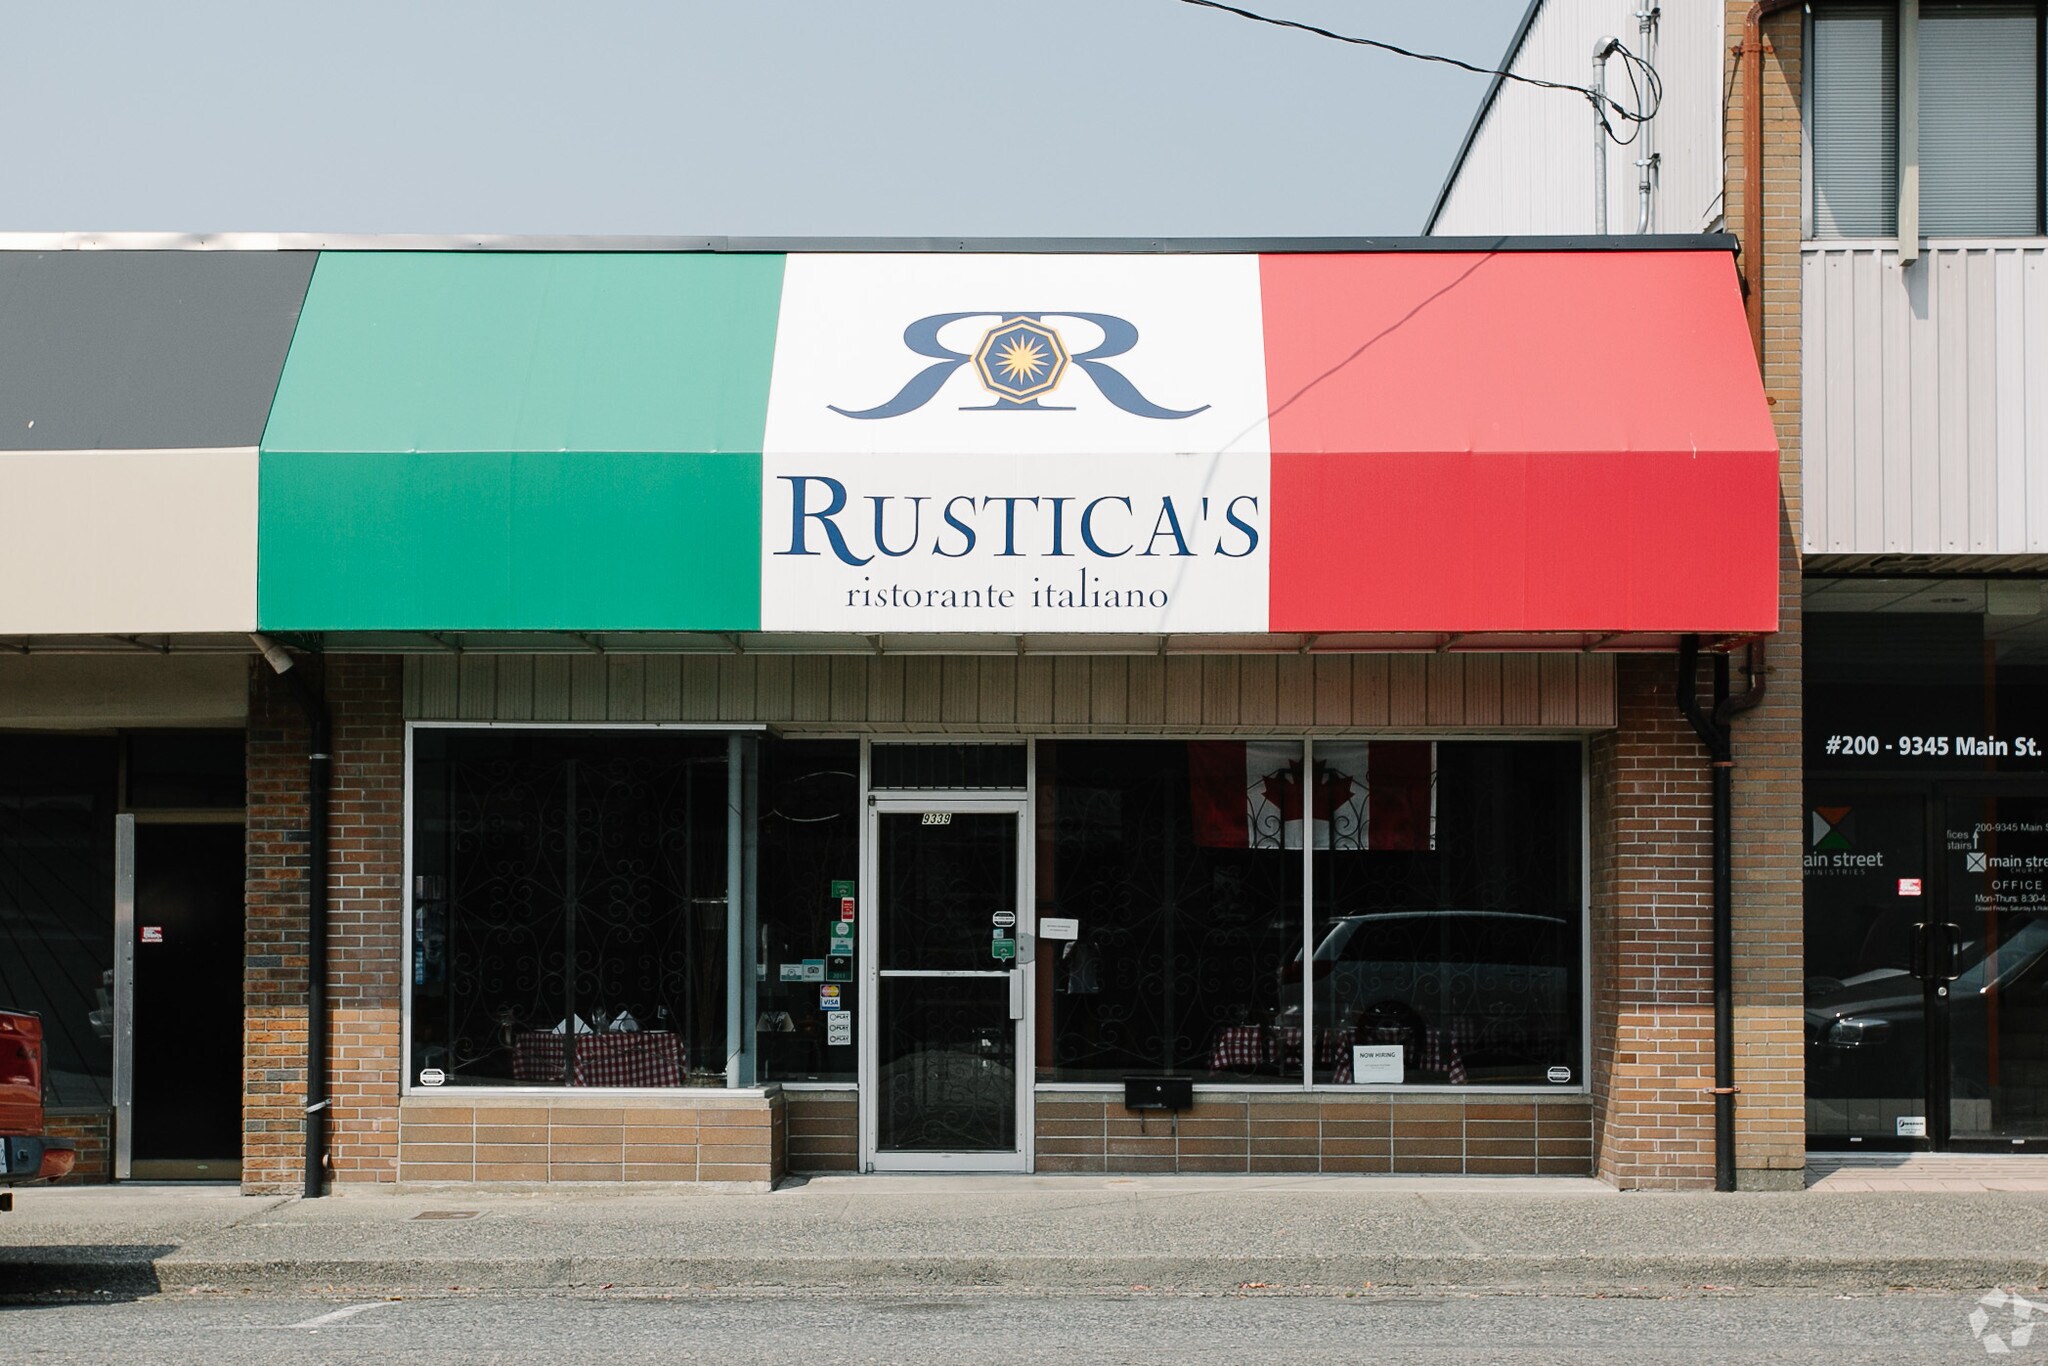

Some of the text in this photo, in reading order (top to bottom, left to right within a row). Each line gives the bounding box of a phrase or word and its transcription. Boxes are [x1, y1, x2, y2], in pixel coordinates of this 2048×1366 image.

[773, 475, 1260, 566] RUSTICA'S
[844, 567, 1169, 608] ristorante italiano
[1825, 735, 1879, 755] #200
[1899, 736, 1949, 756] 9345
[1955, 736, 2008, 756] Main
[2015, 736, 2042, 756] St.
[922, 813, 951, 824] 9339
[1975, 823, 2018, 832] 200-9345
[2020, 823, 2043, 832] Main
[1803, 851, 1884, 867] ain street
[1989, 854, 2022, 867] main
[1991, 880, 2042, 890] OFFICE
